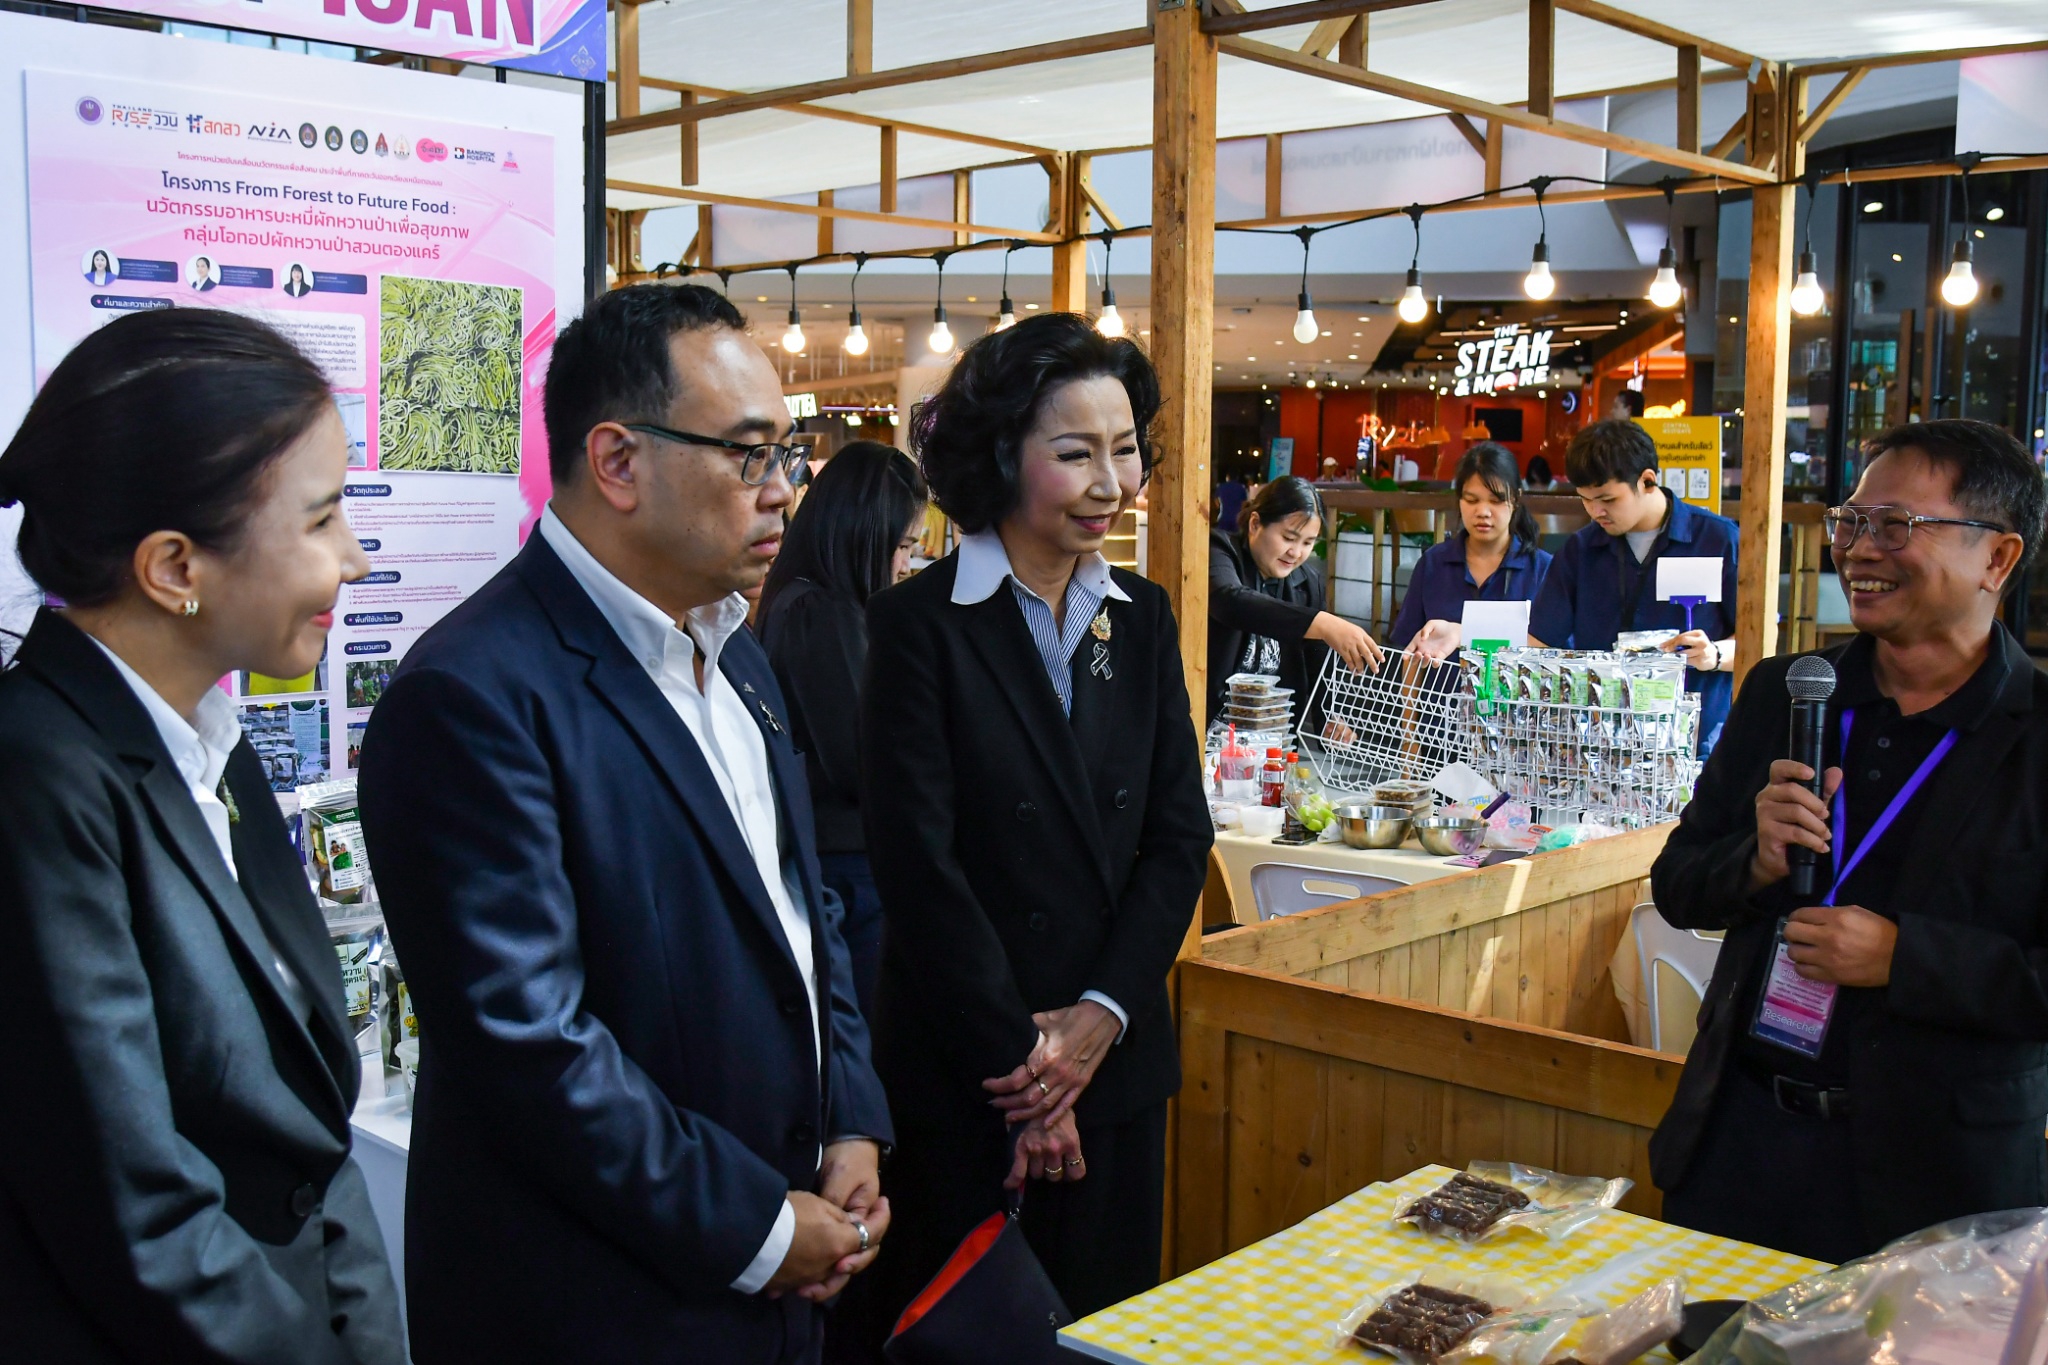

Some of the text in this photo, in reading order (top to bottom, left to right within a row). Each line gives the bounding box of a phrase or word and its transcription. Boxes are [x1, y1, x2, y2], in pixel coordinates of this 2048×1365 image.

[154, 114, 178, 128] ววน
[204, 120, 240, 137] สกสว
[466, 149, 495, 157] BANGKOK
[466, 155, 496, 163] HOSPITAL
[162, 170, 232, 194] โครงการ
[236, 181, 278, 198] From
[283, 185, 333, 204] Forest
[337, 191, 354, 205] to
[358, 193, 408, 211] Future
[412, 198, 449, 214] Food
[146, 196, 469, 240] นวัตกรรมอาหารบะหมี่ผักหวานป่าเพื่อสุขภาพ
[184, 225, 440, 260] กลุ่มโอทอปผักหวานป่าสวนตองแคร์
[1494, 323, 1519, 339] THE
[1454, 330, 1554, 378] STEAK
[352, 486, 388, 496] วัตถุประสงค์
[353, 643, 387, 652] กระบวนการ
[1764, 1007, 1820, 1036] Researcher
